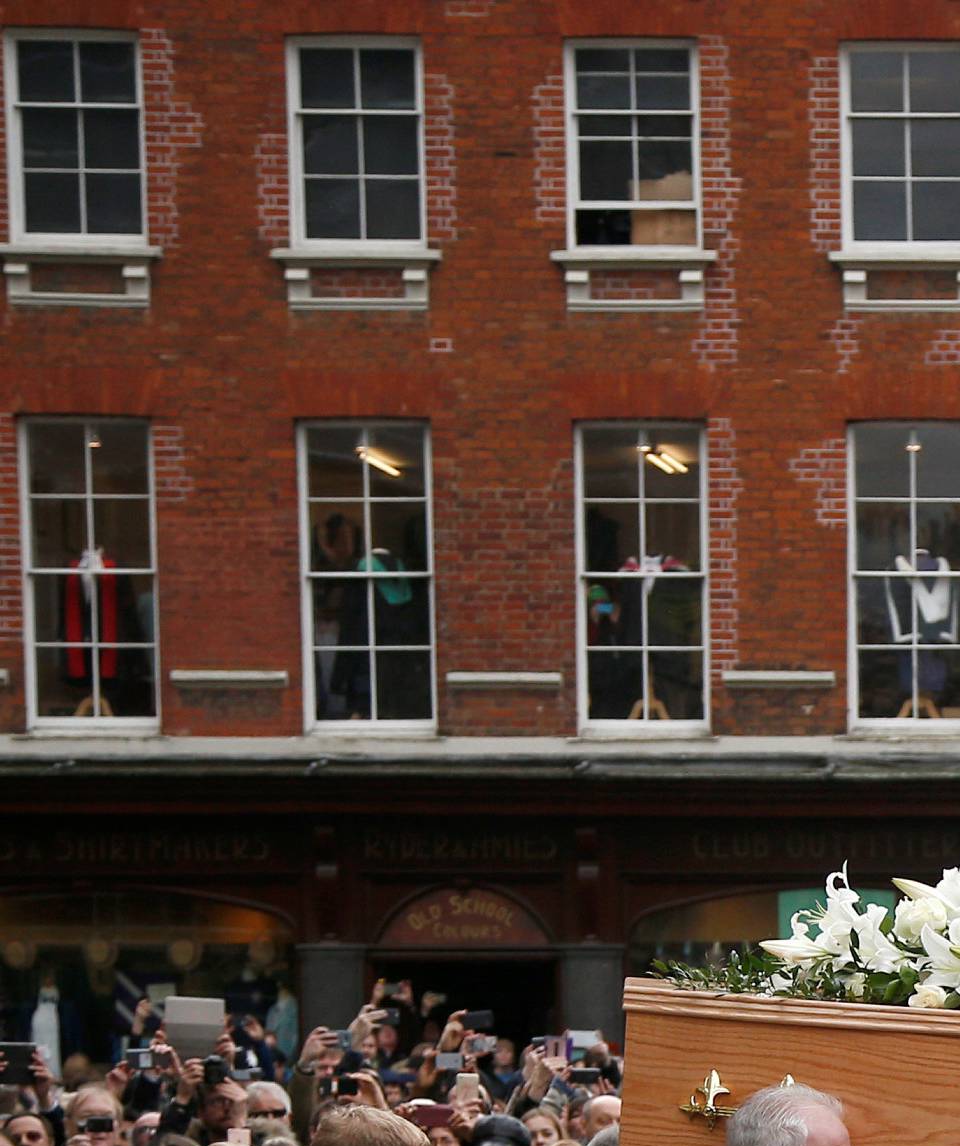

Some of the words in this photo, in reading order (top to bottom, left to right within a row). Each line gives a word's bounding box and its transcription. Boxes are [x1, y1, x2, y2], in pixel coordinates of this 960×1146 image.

[55, 833, 271, 861] SHIRTMAKERS
[691, 832, 770, 860] CLUB
[405, 904, 442, 931] OLD
[448, 896, 513, 928] SCHOOL
[431, 922, 503, 939] COLOURS
